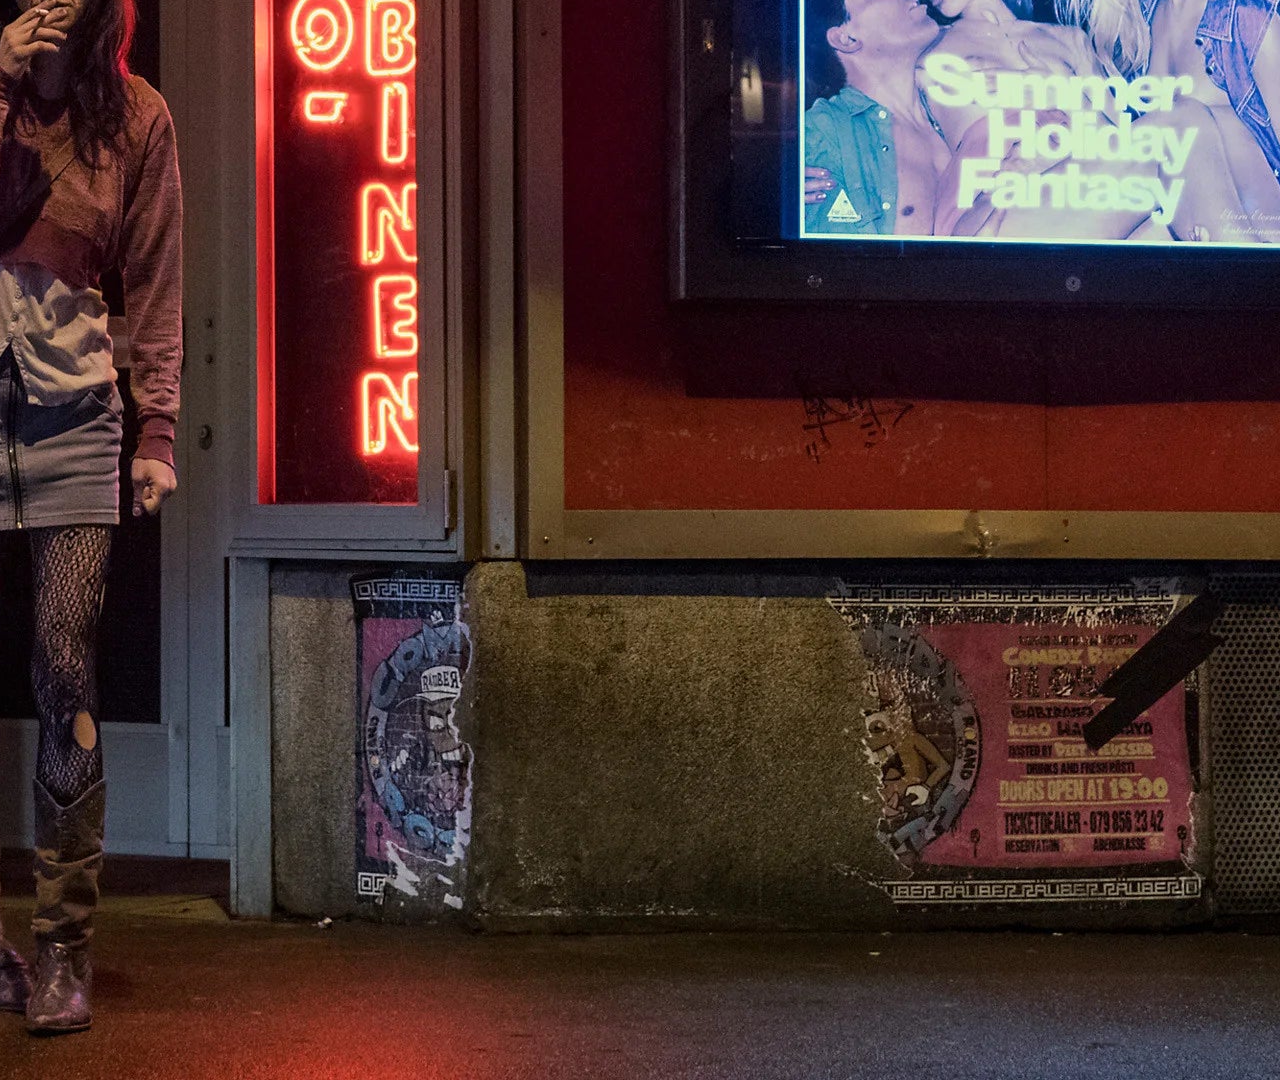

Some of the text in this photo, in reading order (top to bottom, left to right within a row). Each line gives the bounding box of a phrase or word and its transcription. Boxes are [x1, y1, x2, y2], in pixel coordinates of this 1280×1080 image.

[925, 52, 1193, 112] Summer
[987, 108, 1199, 174] Holiday
[956, 156, 1186, 225] Fantasy
[1002, 646, 1084, 666] COMEDY
[1026, 762, 1058, 775] DRINKS
[1060, 762, 1079, 774] AND
[1081, 761, 1108, 774] FRESH
[999, 776, 1169, 801] DOORS OPEN AT 19:00
[1004, 811, 1081, 834] TICKETDEALER
[1090, 810, 1109, 833] 079
[1134, 809, 1148, 832] 23
[1150, 809, 1164, 832] 42
[1005, 838, 1060, 853] RESERVATION
